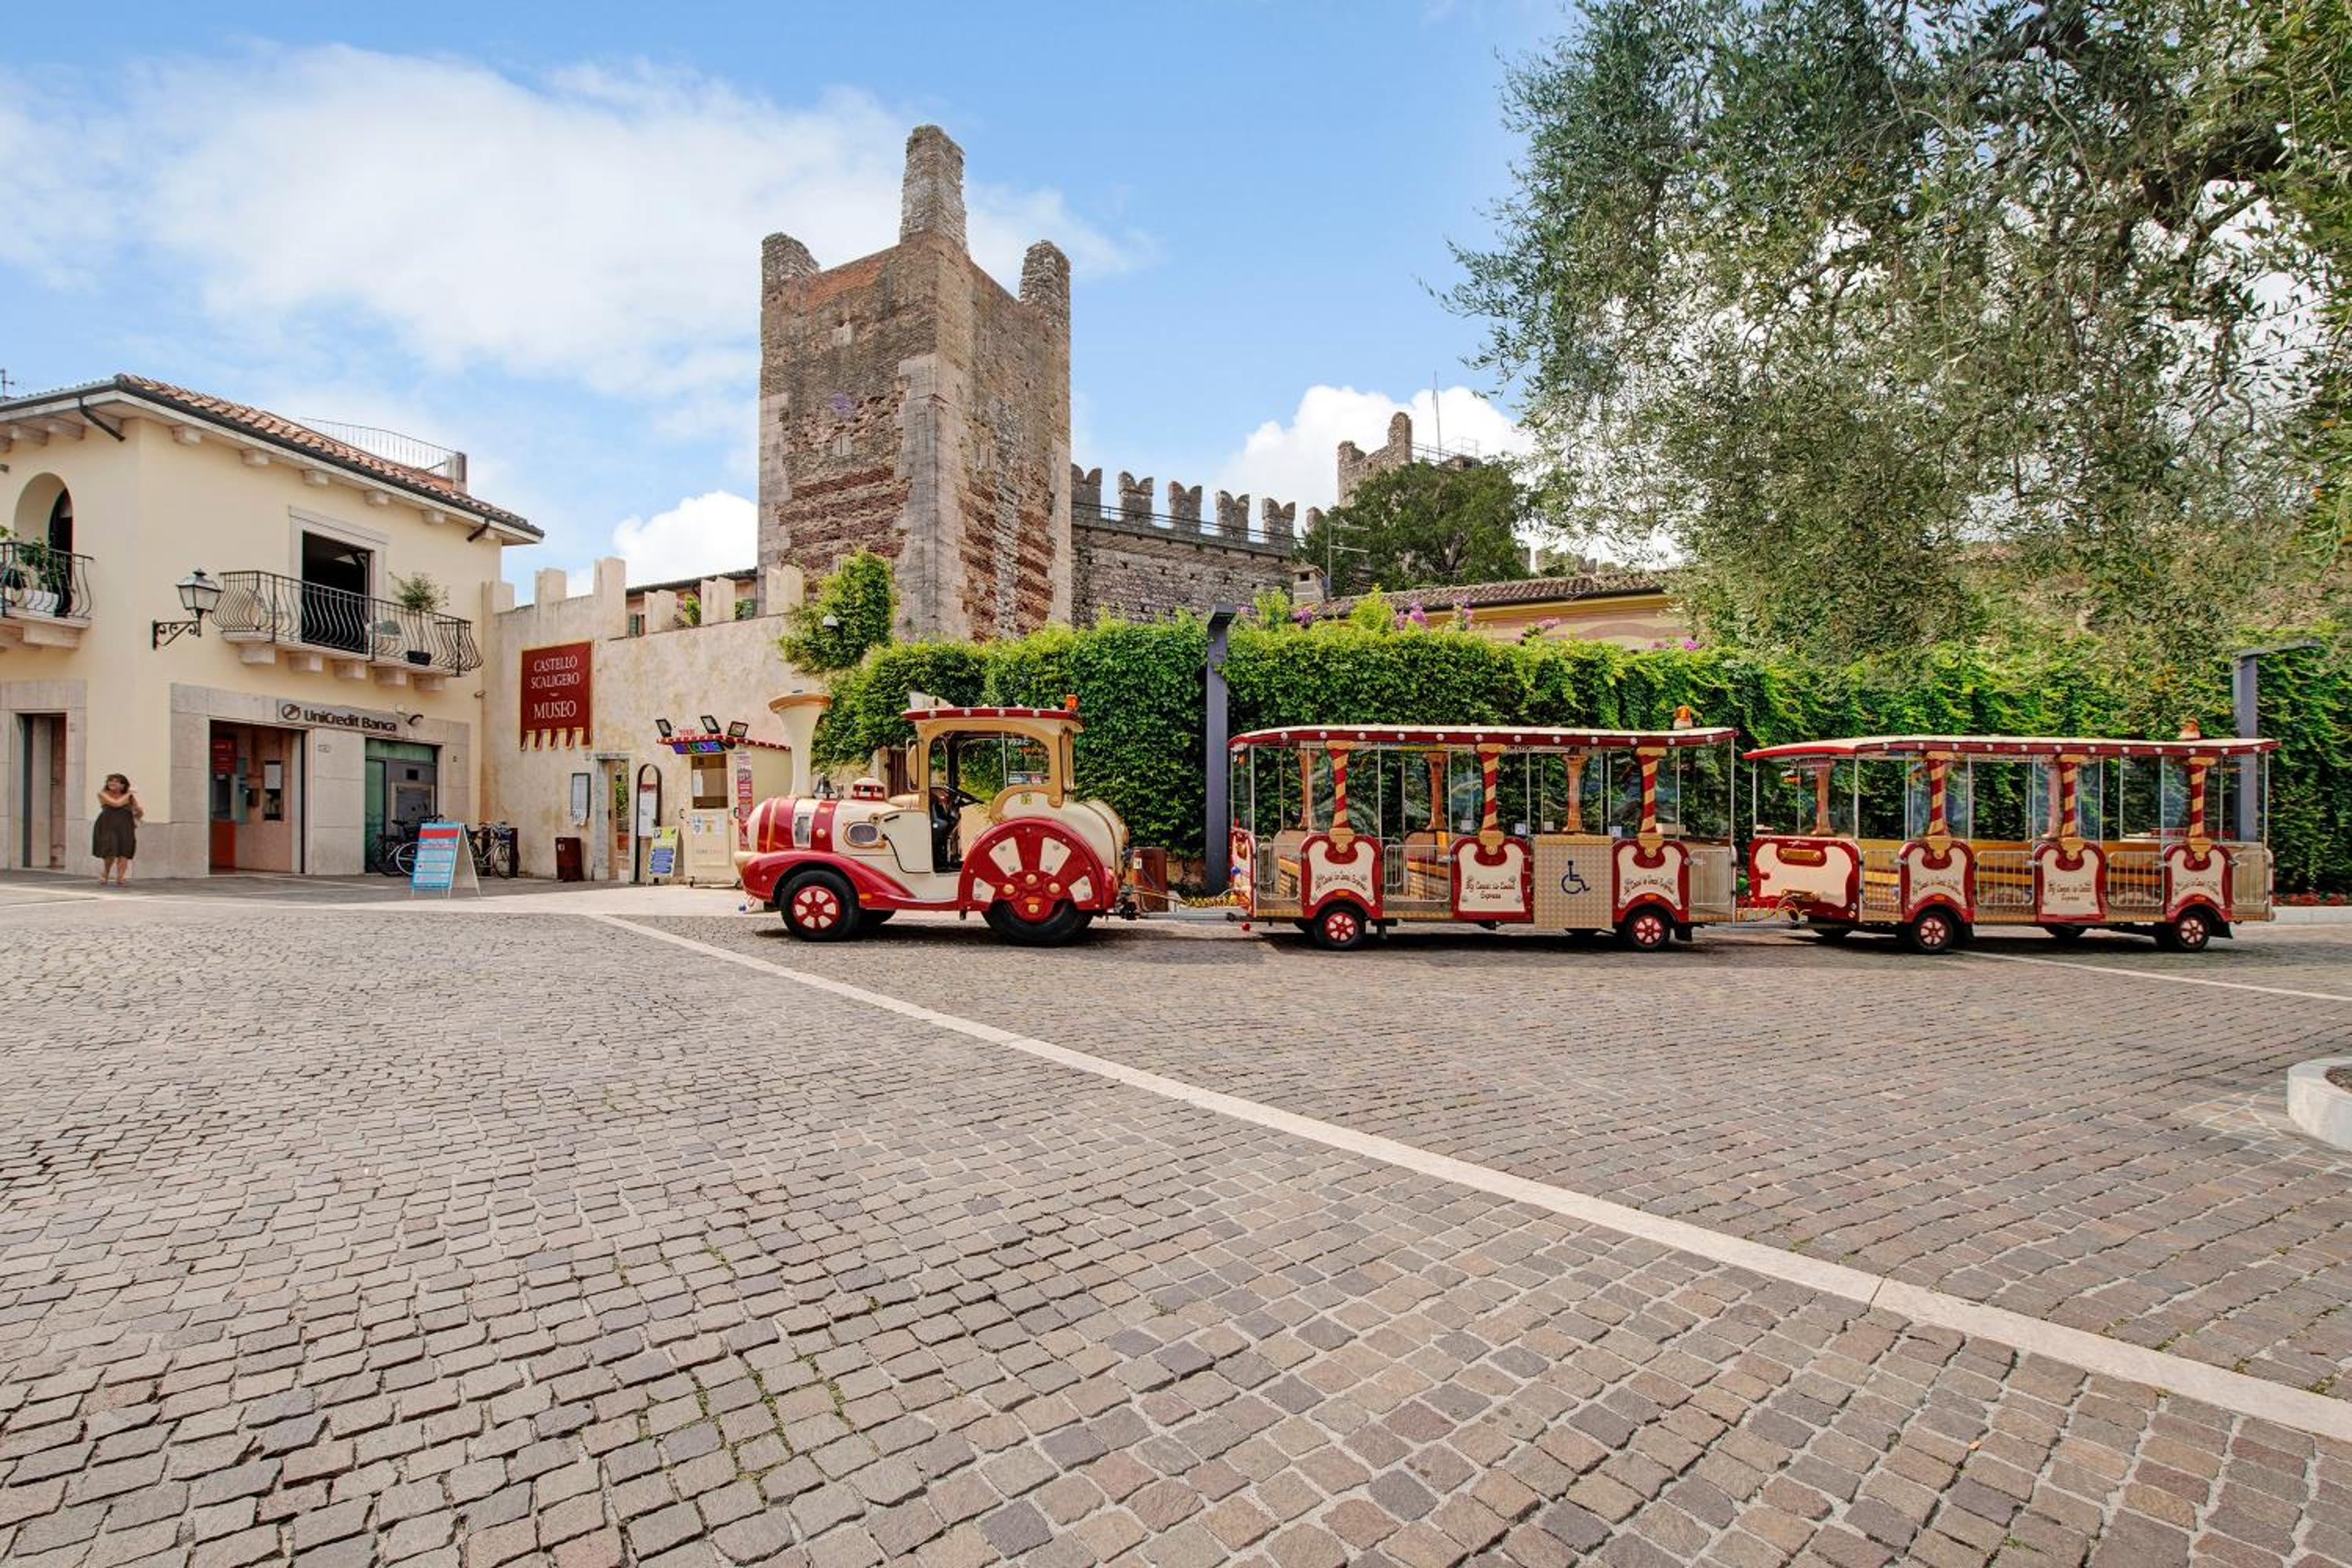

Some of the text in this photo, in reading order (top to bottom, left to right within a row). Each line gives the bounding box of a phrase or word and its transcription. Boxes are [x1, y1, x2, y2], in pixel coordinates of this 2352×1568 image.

[534, 655, 578, 673] CASTELLO
[531, 672, 580, 689] SCALIGERO
[534, 700, 576, 720] MUSEO
[304, 710, 397, 731] UniCredit Banca
